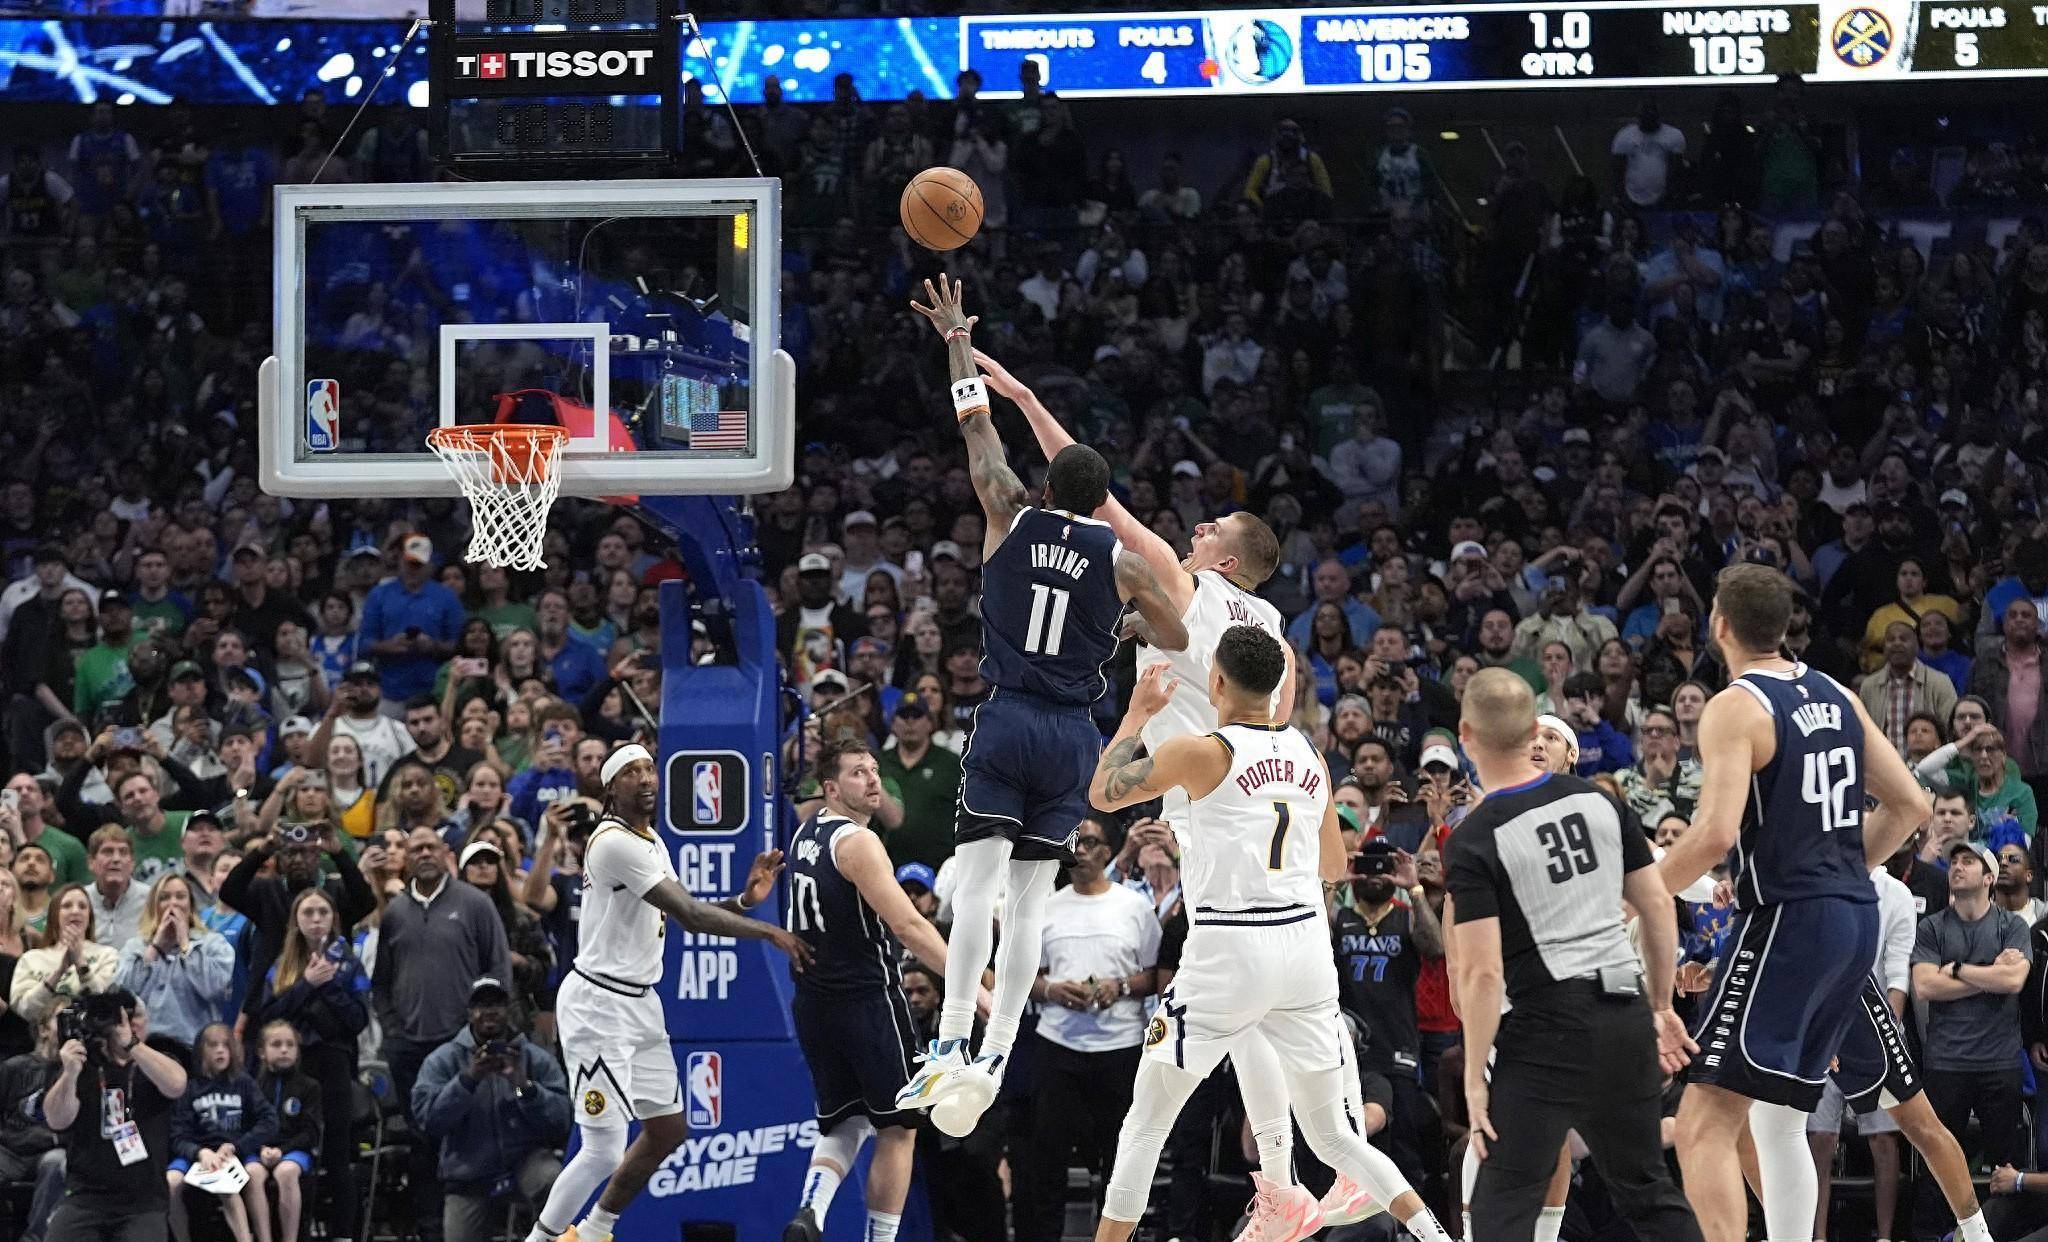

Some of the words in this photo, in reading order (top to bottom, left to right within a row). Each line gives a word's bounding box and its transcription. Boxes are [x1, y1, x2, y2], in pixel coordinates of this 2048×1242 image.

[1315, 16, 1469, 42] MAVERICKS
[1529, 11, 1590, 48] 1.0
[1663, 9, 1790, 35] NUGGETS
[1931, 6, 2006, 29] FOULS
[1119, 26, 1194, 47] FOULS
[1954, 33, 1980, 66] 5
[510, 50, 654, 78] TISSOT
[1141, 51, 1167, 84] 4
[1356, 43, 1431, 81] 105
[1689, 36, 1765, 75] 105
[1030, 544, 1090, 580] IRVING
[1024, 583, 1070, 655] 11
[1236, 758, 1294, 796] PORTER
[1299, 768, 1321, 799] JR.
[1801, 746, 1859, 832] 42
[1268, 801, 1292, 871] 1
[1536, 812, 1599, 884] 39
[679, 843, 736, 893] GET
[1342, 934, 1402, 957] MAVS
[677, 950, 738, 1000] APP
[1351, 954, 1389, 982] 77
[647, 1156, 758, 1198] GAME
